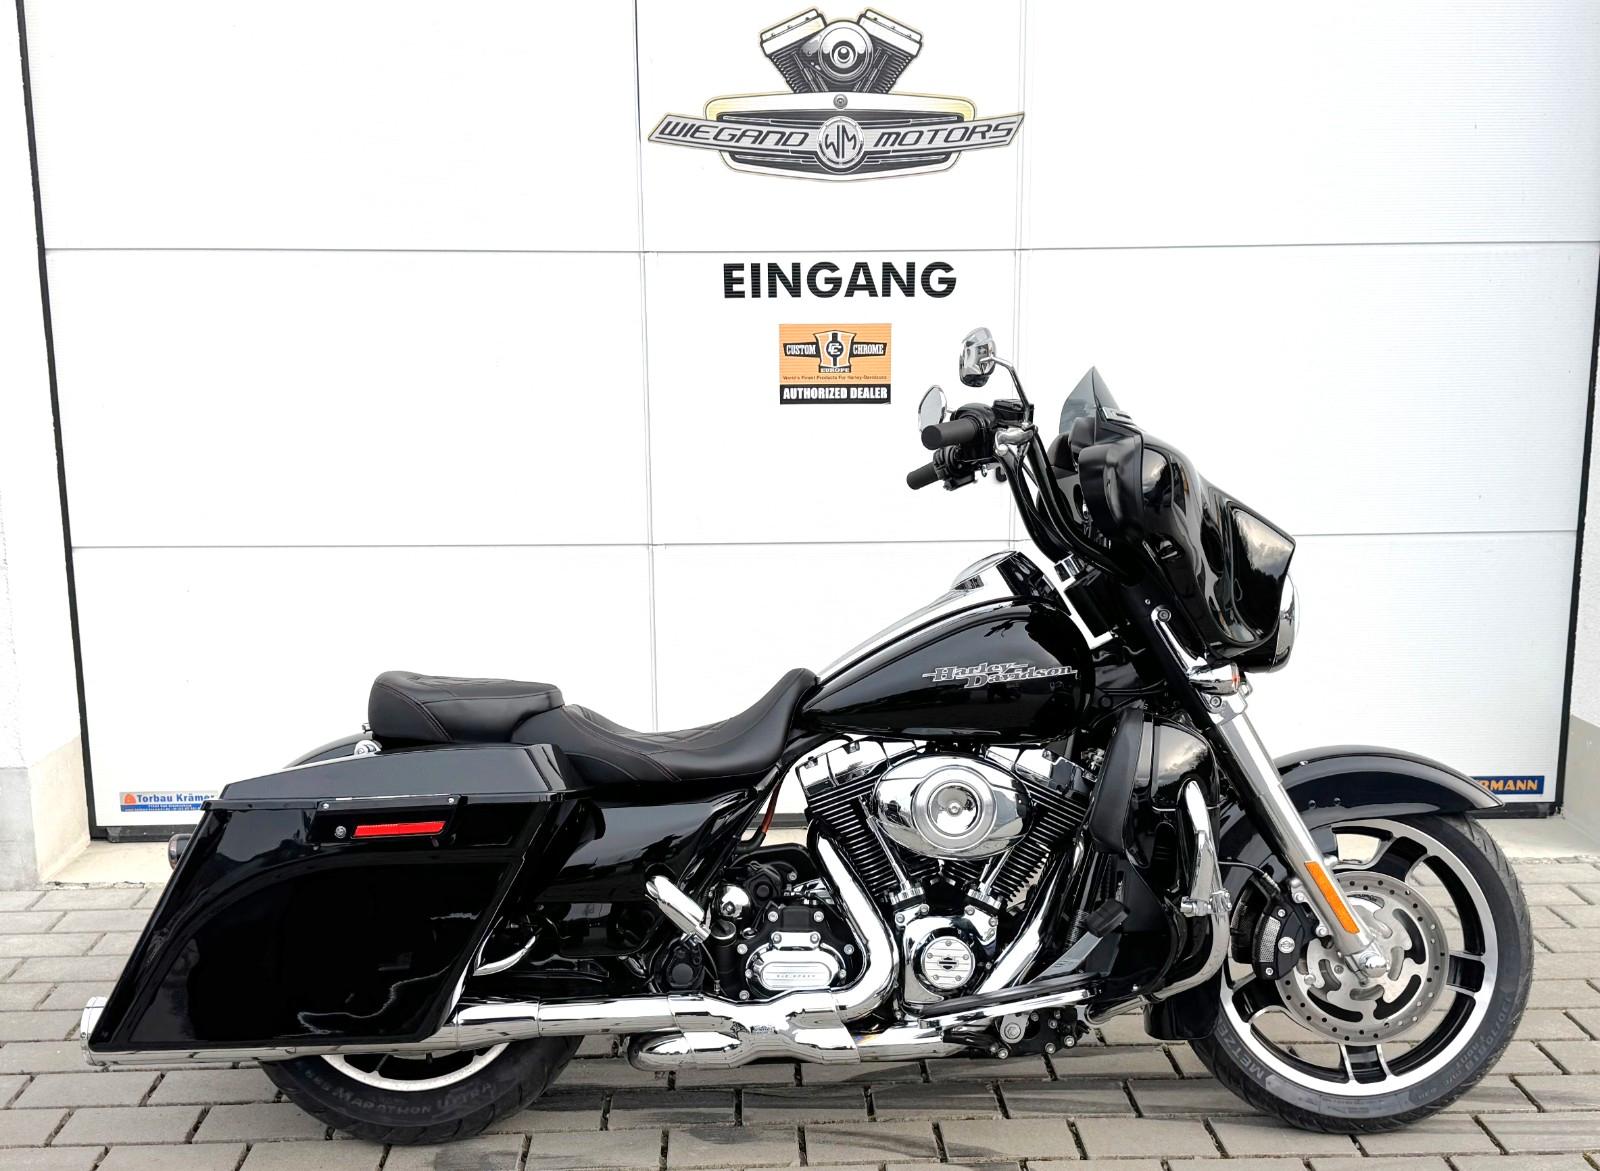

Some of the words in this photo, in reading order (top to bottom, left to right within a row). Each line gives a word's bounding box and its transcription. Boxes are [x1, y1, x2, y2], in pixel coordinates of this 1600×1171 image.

[658, 120, 809, 147] WIEGAND
[873, 120, 1018, 148] MOTORS
[824, 124, 857, 160] WM
[723, 261, 957, 299] EINGANG
[786, 344, 816, 355] CUSTOM
[852, 343, 884, 355] CHROME
[783, 387, 848, 399] AUTHORIZED
[850, 387, 888, 399] DEALER
[922, 662, 1029, 682] Harley
[964, 665, 1078, 689] Davidson
[1477, 779, 1538, 791] RMANN
[137, 794, 172, 803] Torbau
